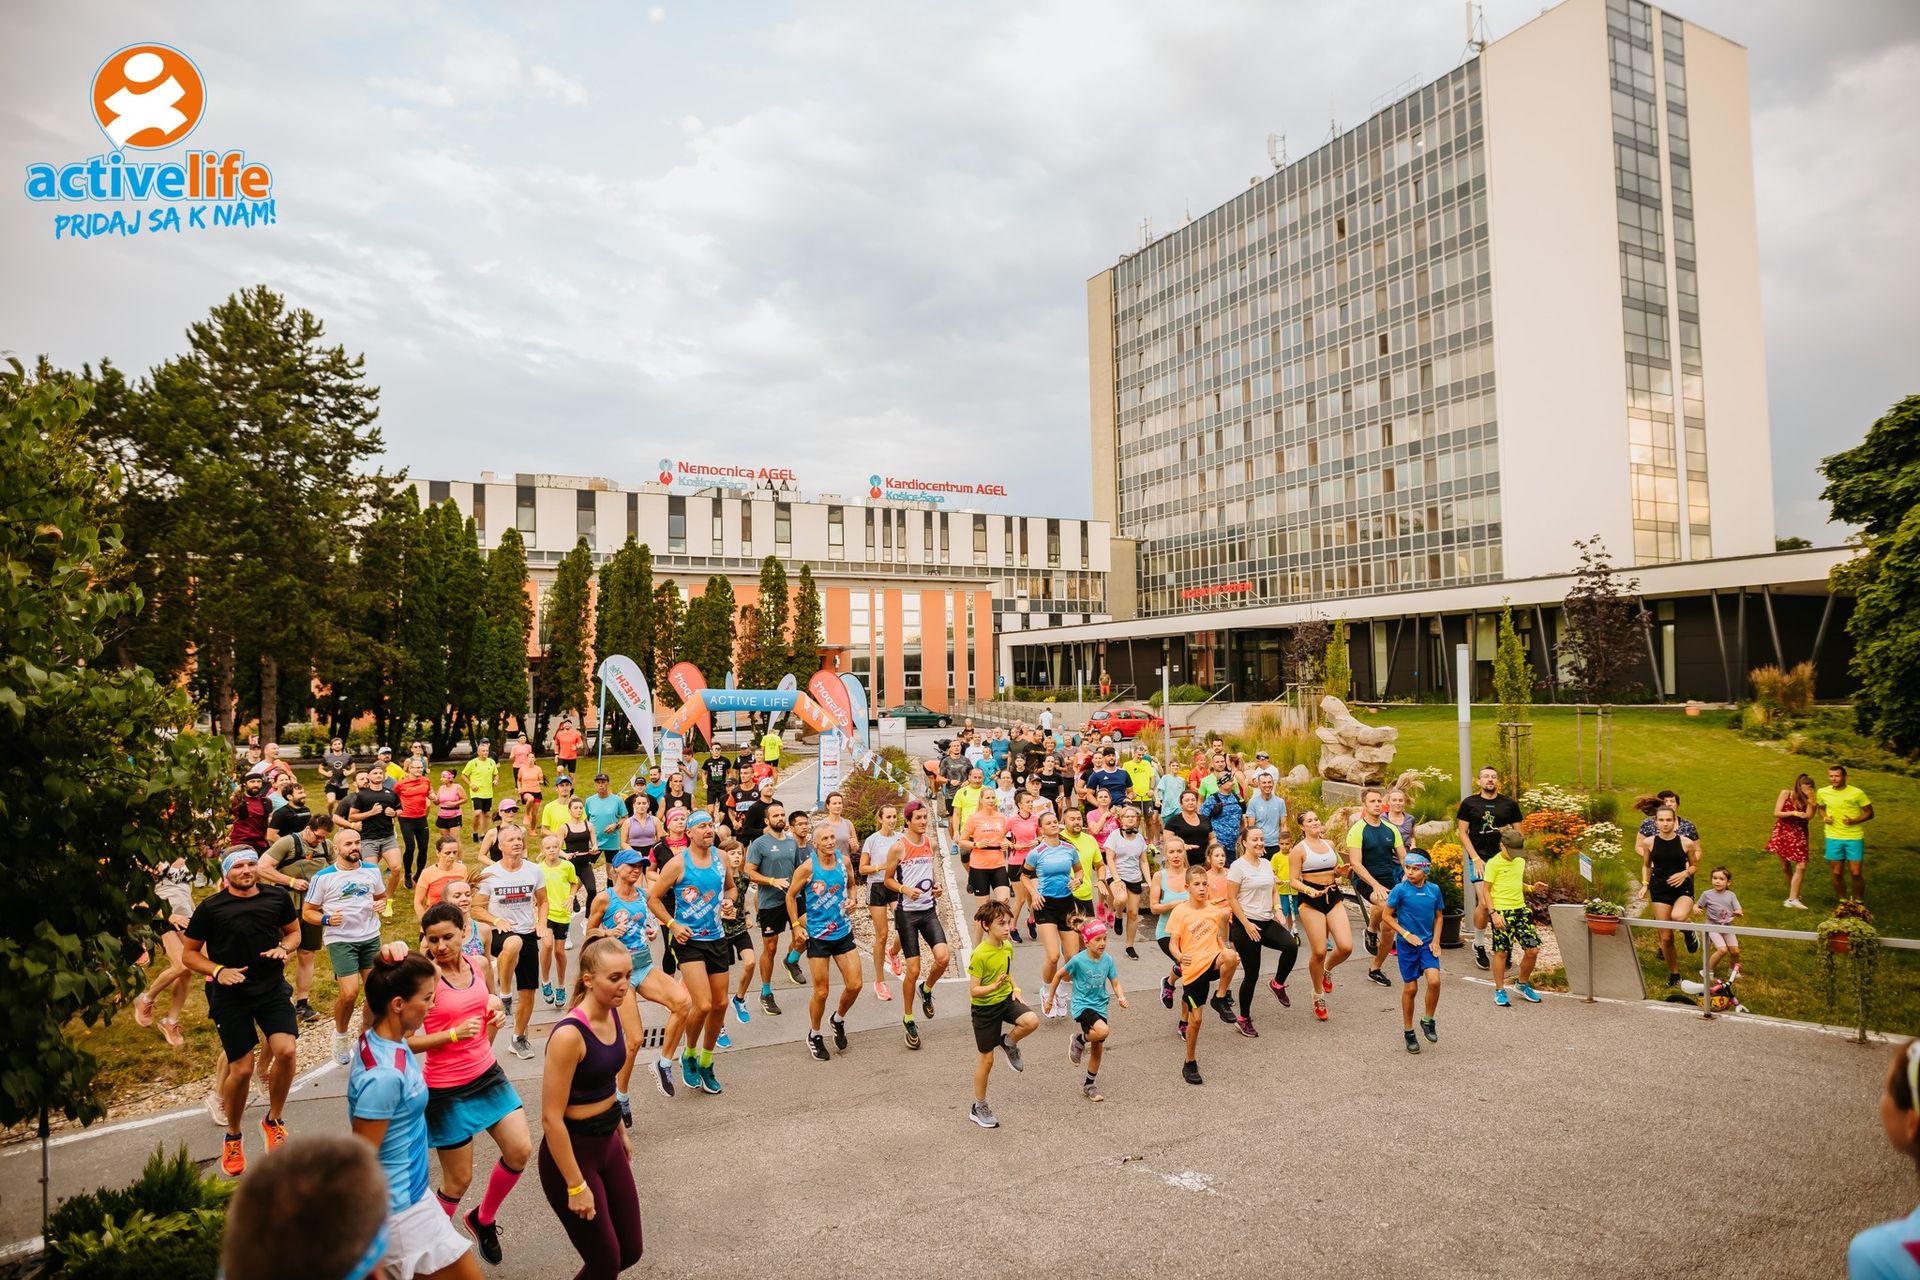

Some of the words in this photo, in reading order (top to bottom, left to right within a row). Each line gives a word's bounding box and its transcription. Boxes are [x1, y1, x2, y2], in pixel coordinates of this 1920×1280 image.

[678, 461, 755, 478] Nemocnica
[758, 467, 797, 481] AGEL
[885, 477, 973, 493] Kardiocentrum
[975, 483, 1008, 497] AGEL
[709, 695, 757, 707] ACTIVE
[763, 697, 790, 708] LIFE
